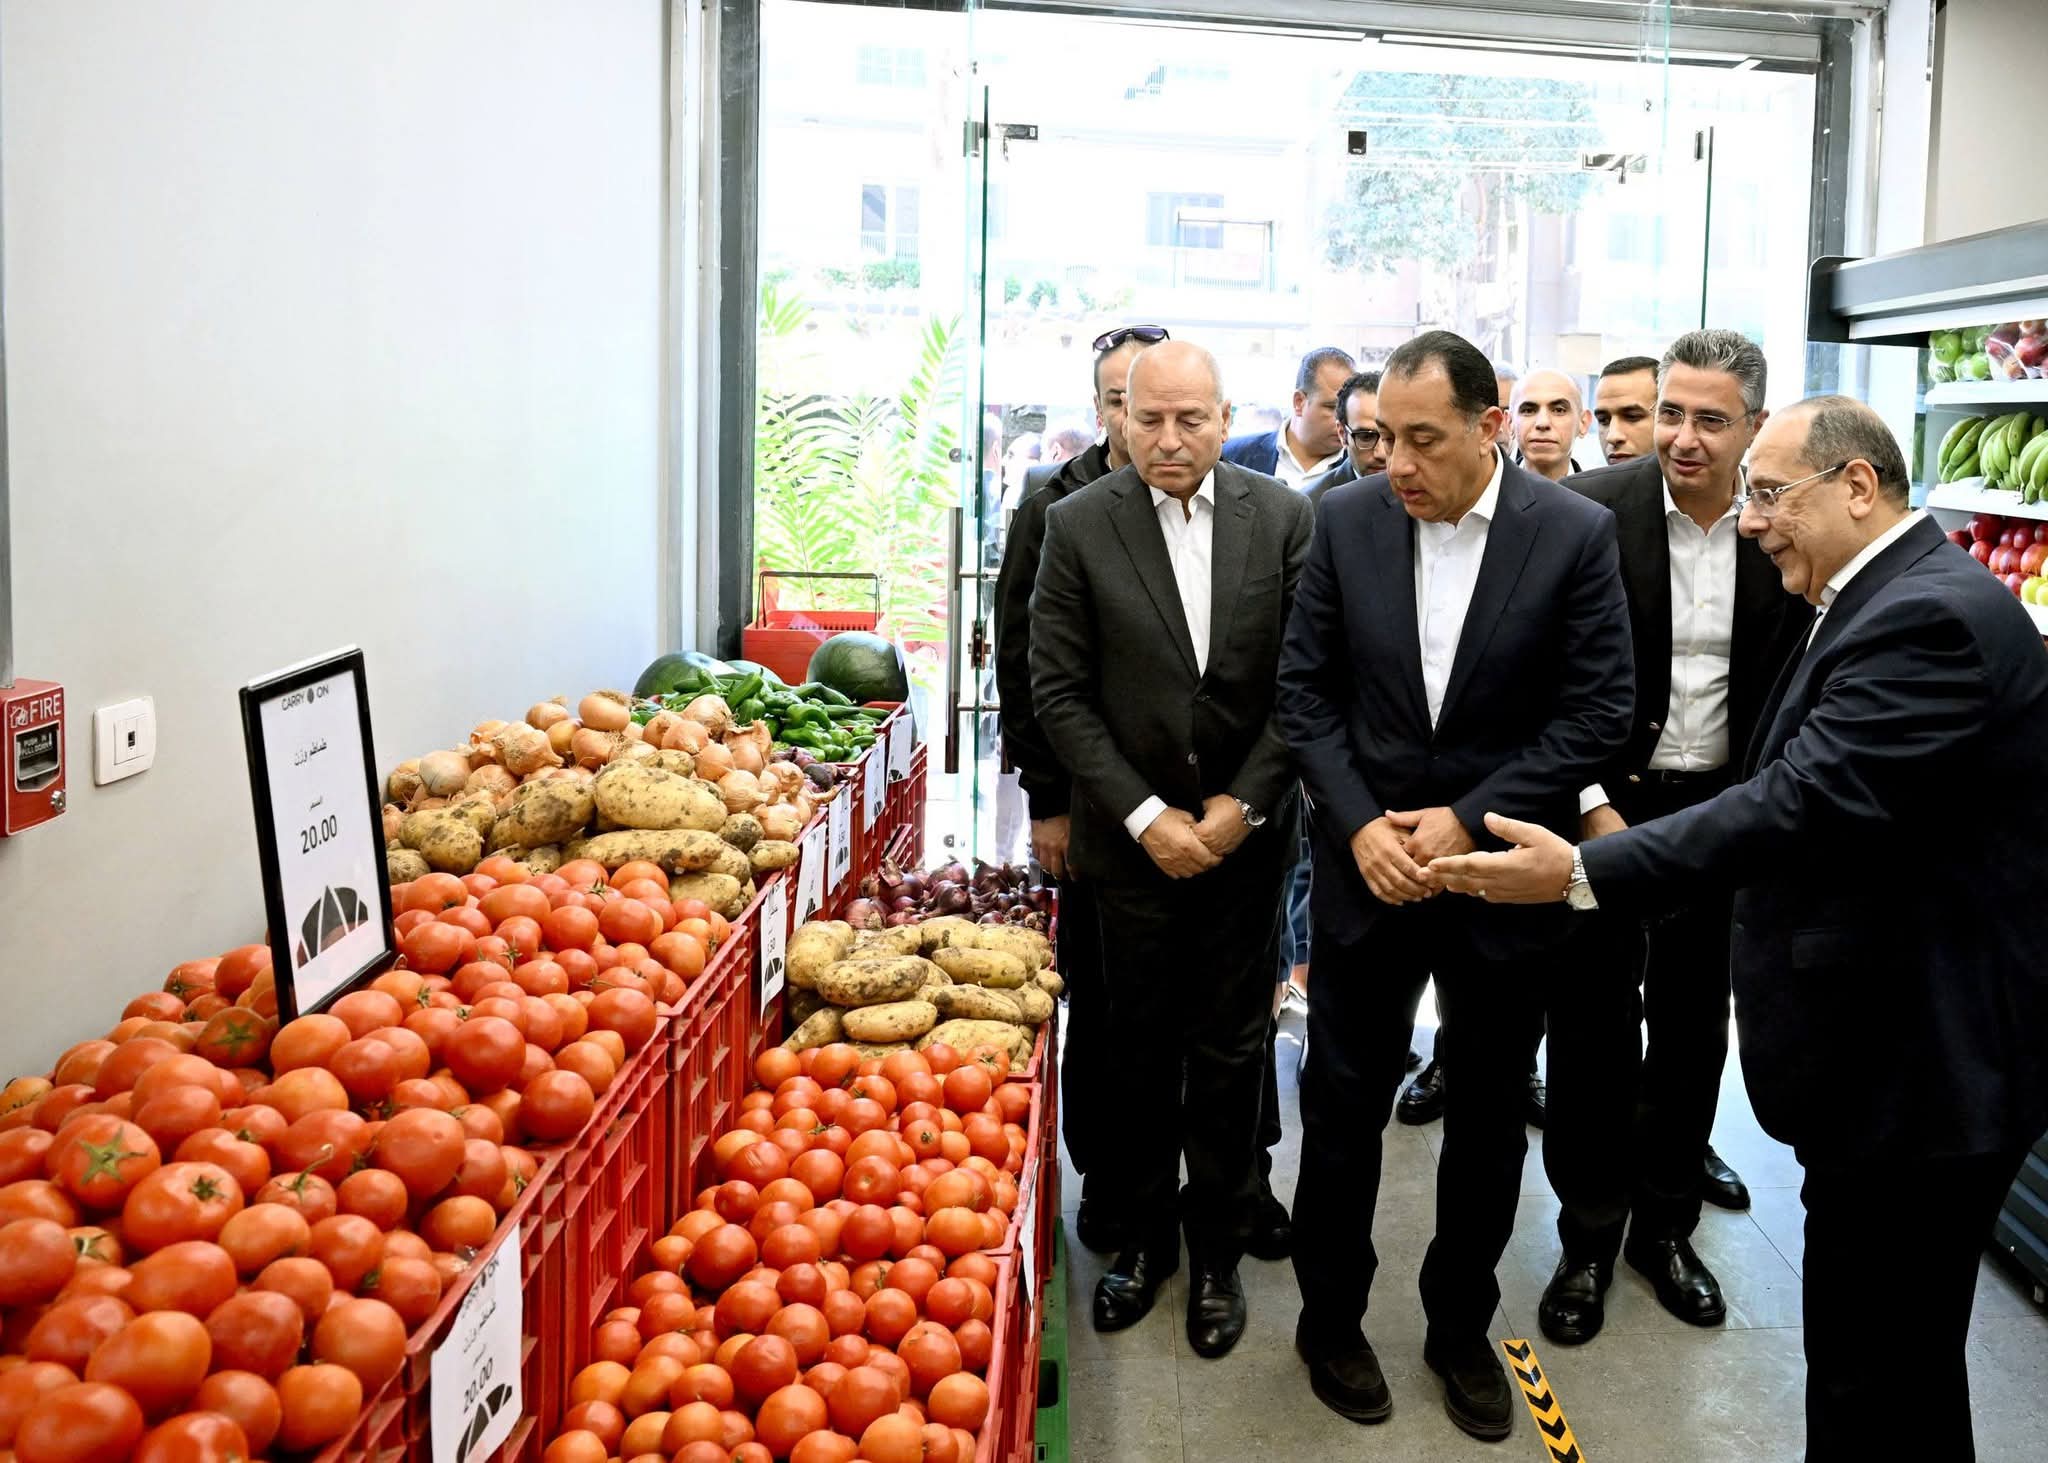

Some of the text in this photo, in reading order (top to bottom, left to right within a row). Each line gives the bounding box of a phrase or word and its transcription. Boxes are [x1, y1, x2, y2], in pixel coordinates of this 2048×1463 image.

[30, 693, 61, 722] FIRE
[281, 684, 329, 710] CARRY ON
[300, 814, 337, 854] 20.00
[463, 1357, 493, 1413] 20.00
